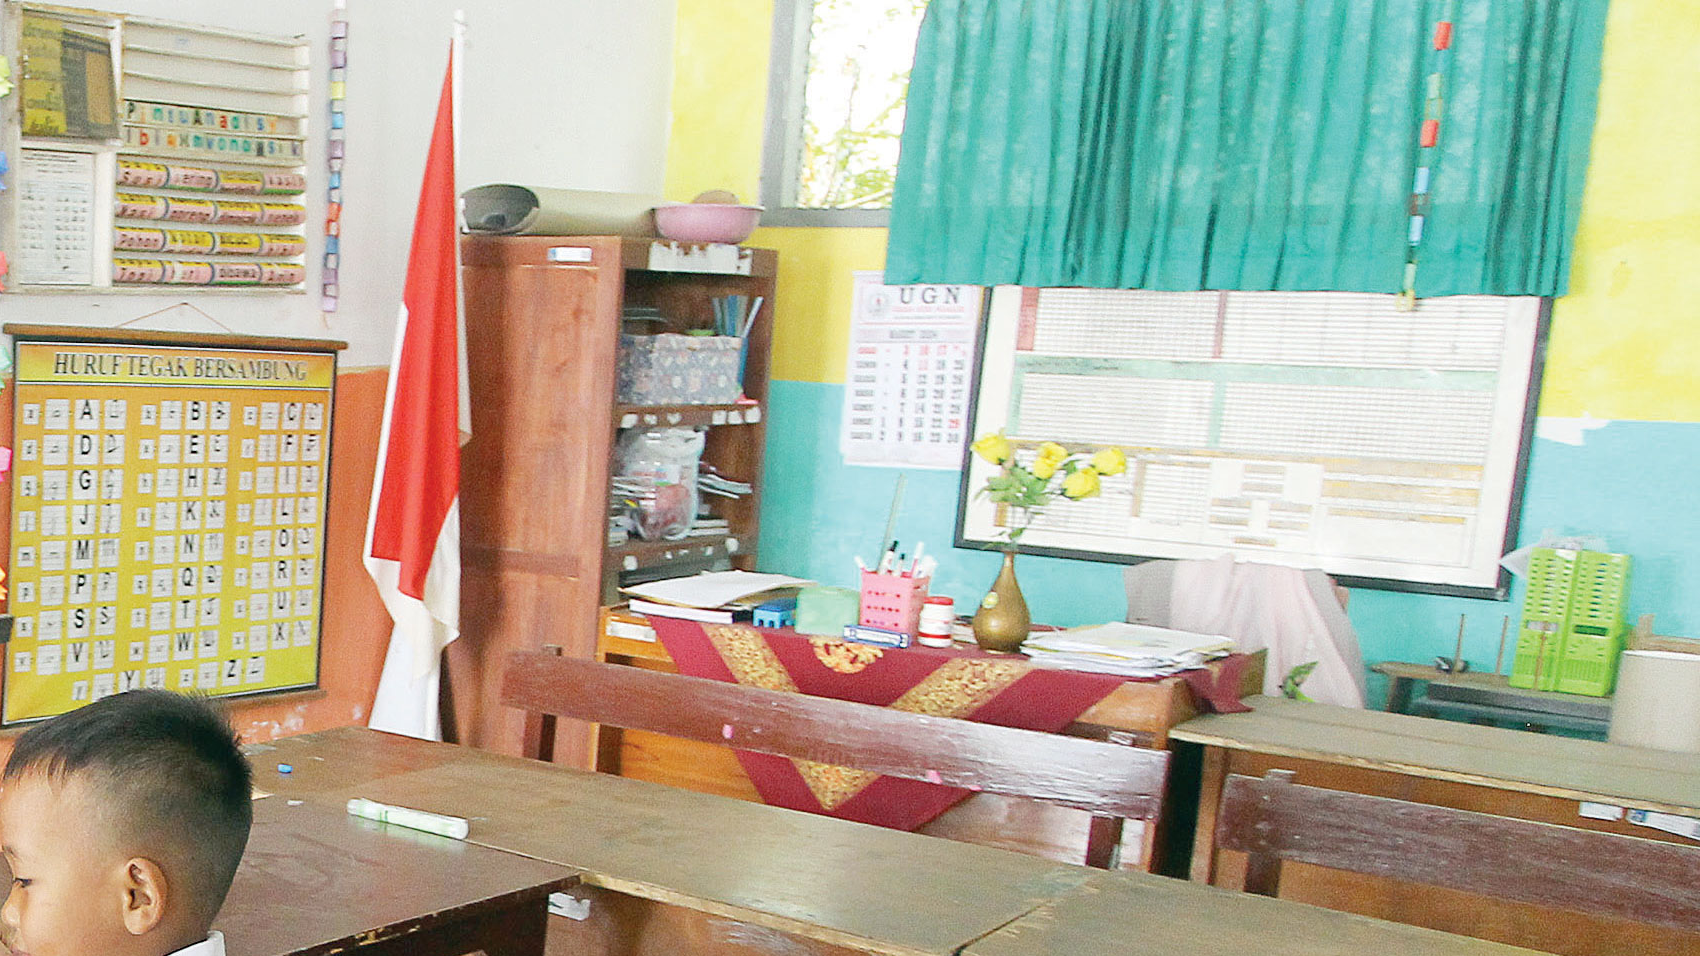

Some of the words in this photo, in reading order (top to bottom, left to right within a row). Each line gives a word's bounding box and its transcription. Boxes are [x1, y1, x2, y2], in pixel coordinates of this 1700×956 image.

[54, 353, 121, 375] HURUF
[126, 355, 188, 378] TEGAK
[192, 357, 308, 382] BERSAMBUNG
[80, 399, 93, 420] A
[192, 401, 200, 420] B
[81, 434, 92, 455] D
[190, 434, 198, 454] E
[79, 469, 91, 490] G
[187, 468, 198, 487] H
[80, 504, 88, 525] J
[186, 501, 197, 520] K
[184, 535, 195, 554] N
[279, 529, 289, 547] O
[76, 574, 86, 594] P
[182, 567, 193, 587] Q
[278, 560, 287, 578] R
[74, 608, 85, 628] S
[182, 600, 190, 619] T
[73, 643, 83, 662] V
[276, 622, 285, 640] X
[227, 659, 237, 677] Z
